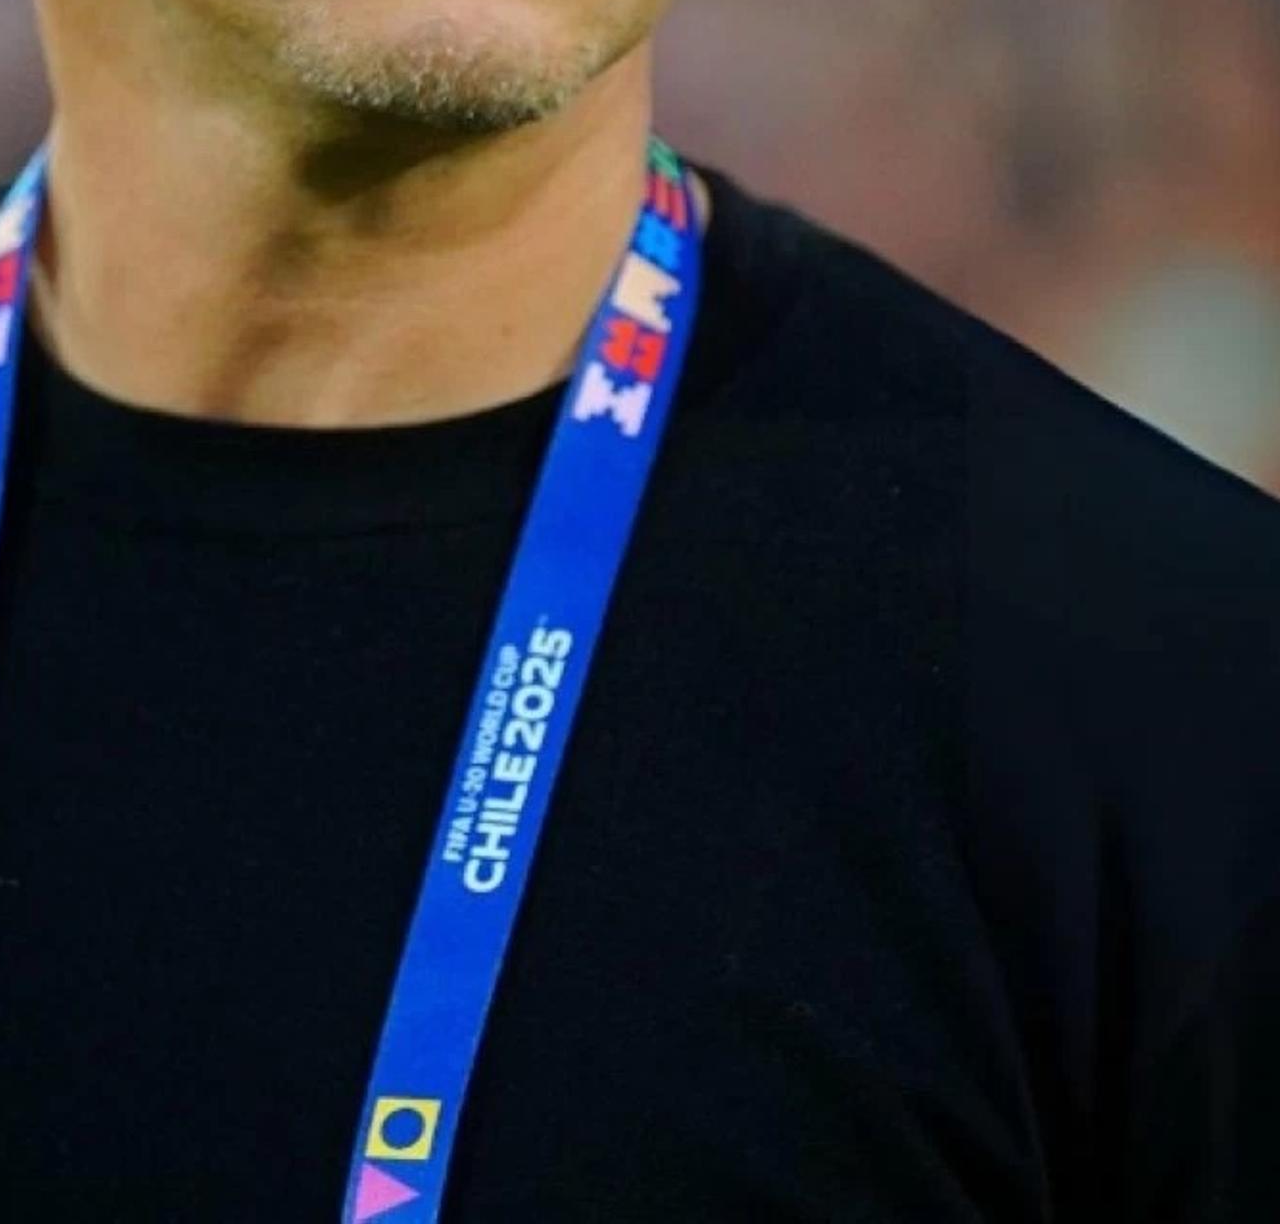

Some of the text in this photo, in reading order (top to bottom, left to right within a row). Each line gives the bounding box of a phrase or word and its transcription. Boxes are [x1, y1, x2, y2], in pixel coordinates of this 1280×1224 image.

[443, 644, 520, 862] FIFA U-20 WORLD CUP
[464, 627, 572, 892] CHILE 2025
